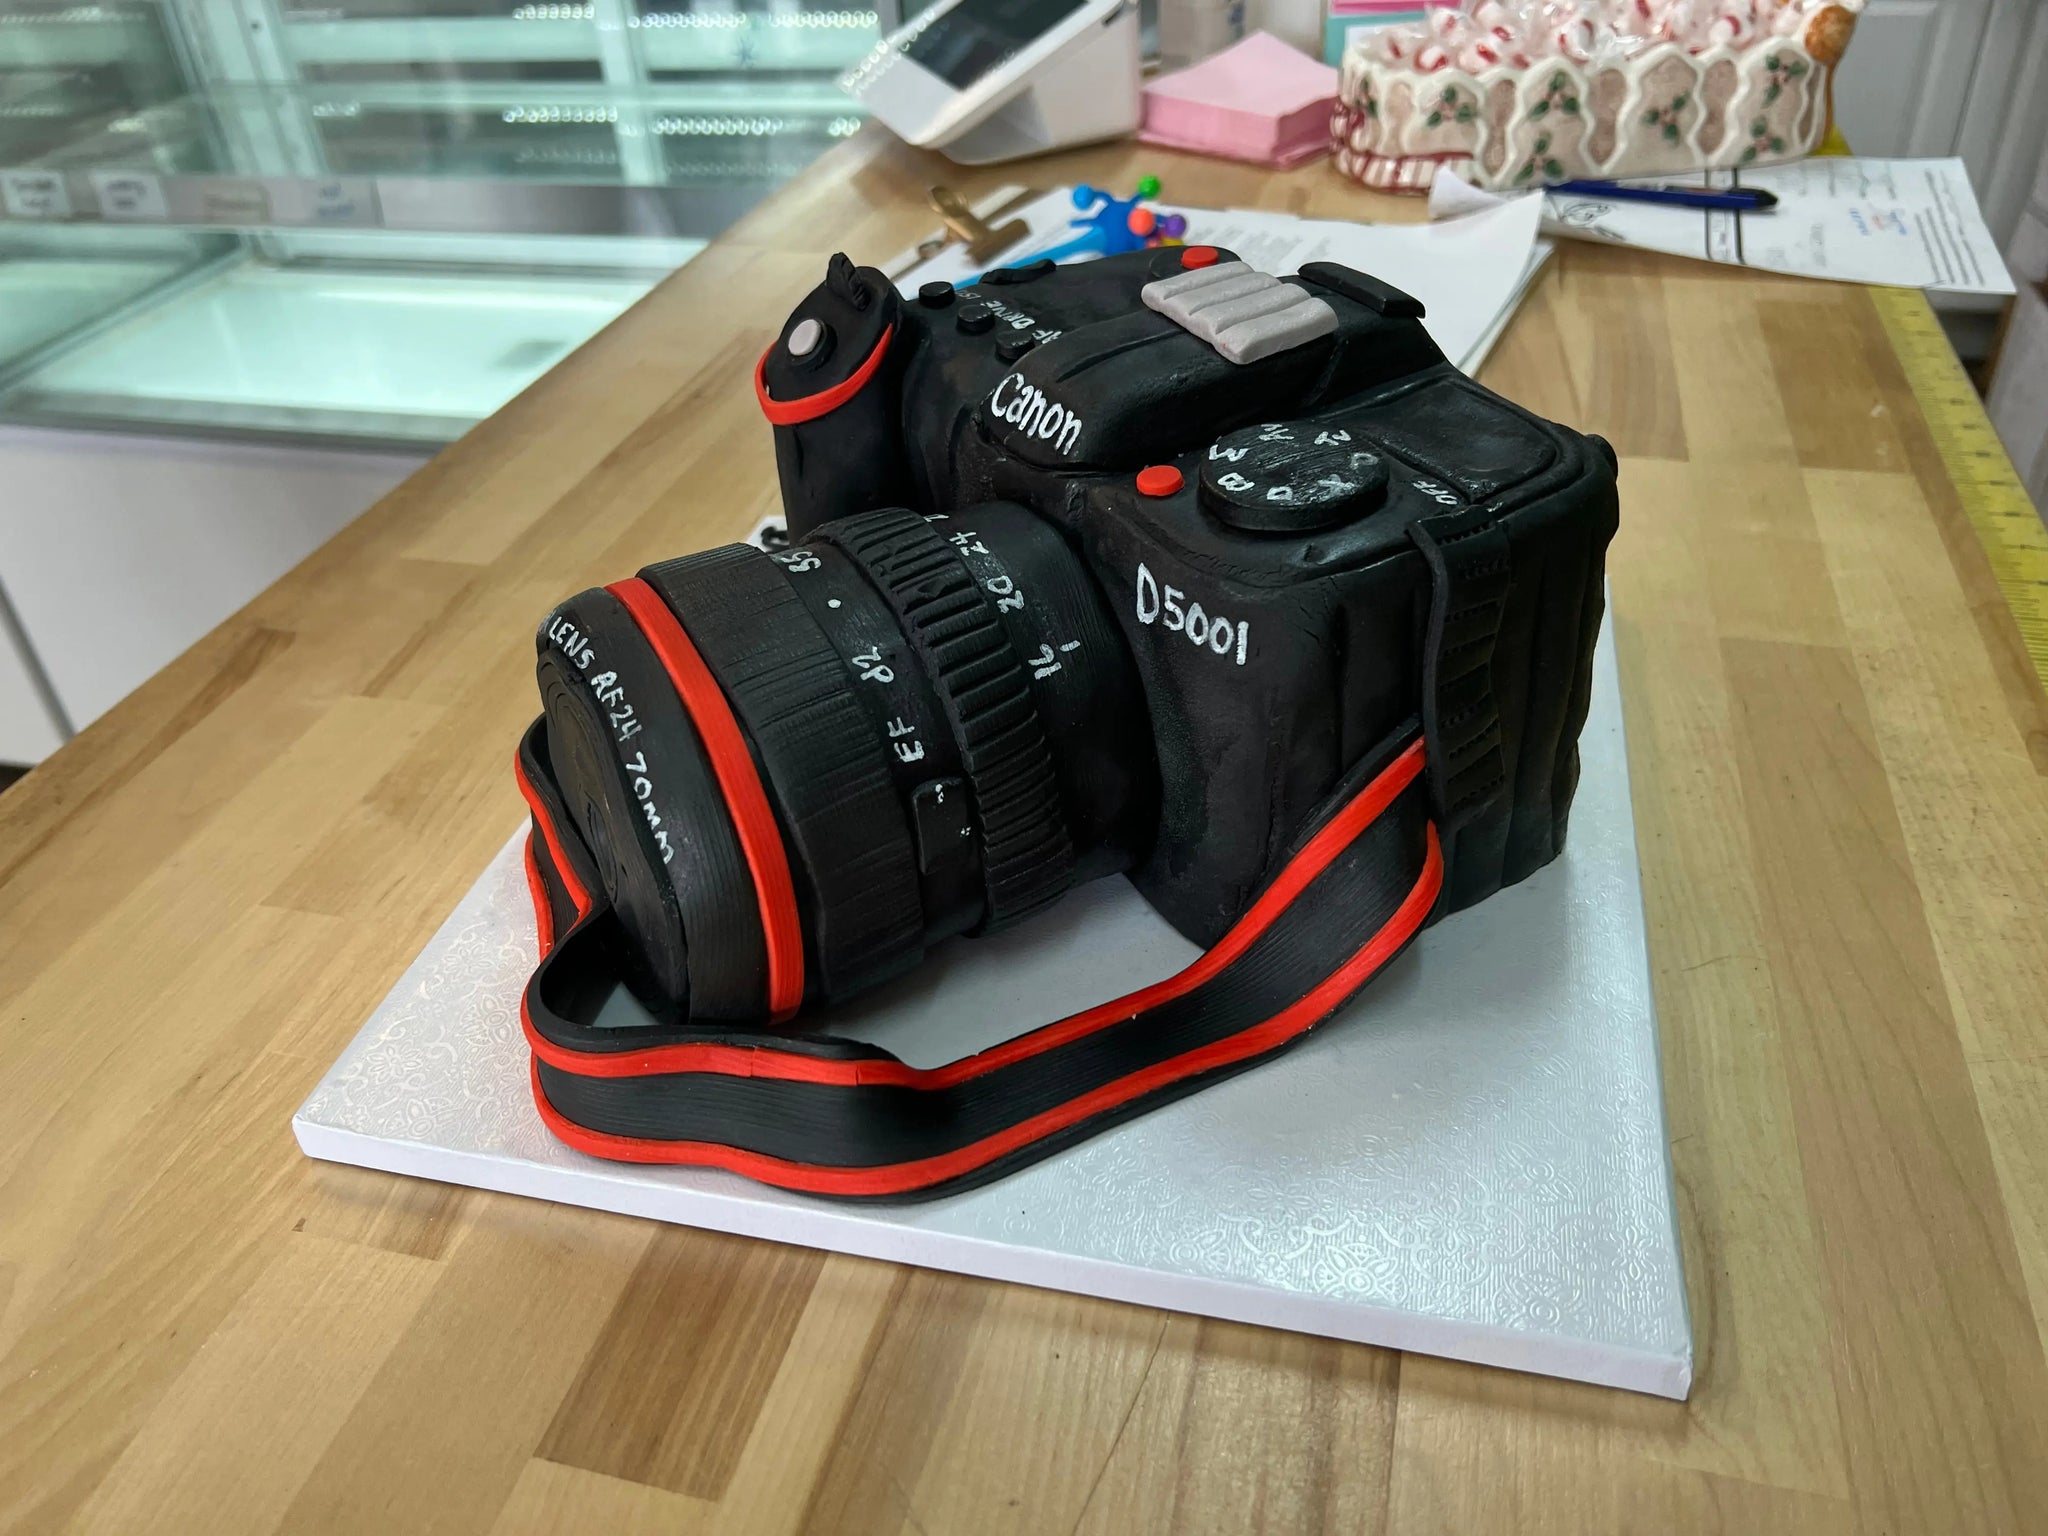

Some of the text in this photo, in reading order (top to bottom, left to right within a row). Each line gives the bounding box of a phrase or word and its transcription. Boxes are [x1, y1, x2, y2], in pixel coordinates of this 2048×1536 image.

[986, 300, 1036, 330] DRIVE
[990, 372, 1083, 456] Canon
[1413, 480, 1458, 506] OFF
[1136, 562, 1250, 666] D5001
[549, 615, 596, 670] LENS
[886, 716, 926, 763] EF
